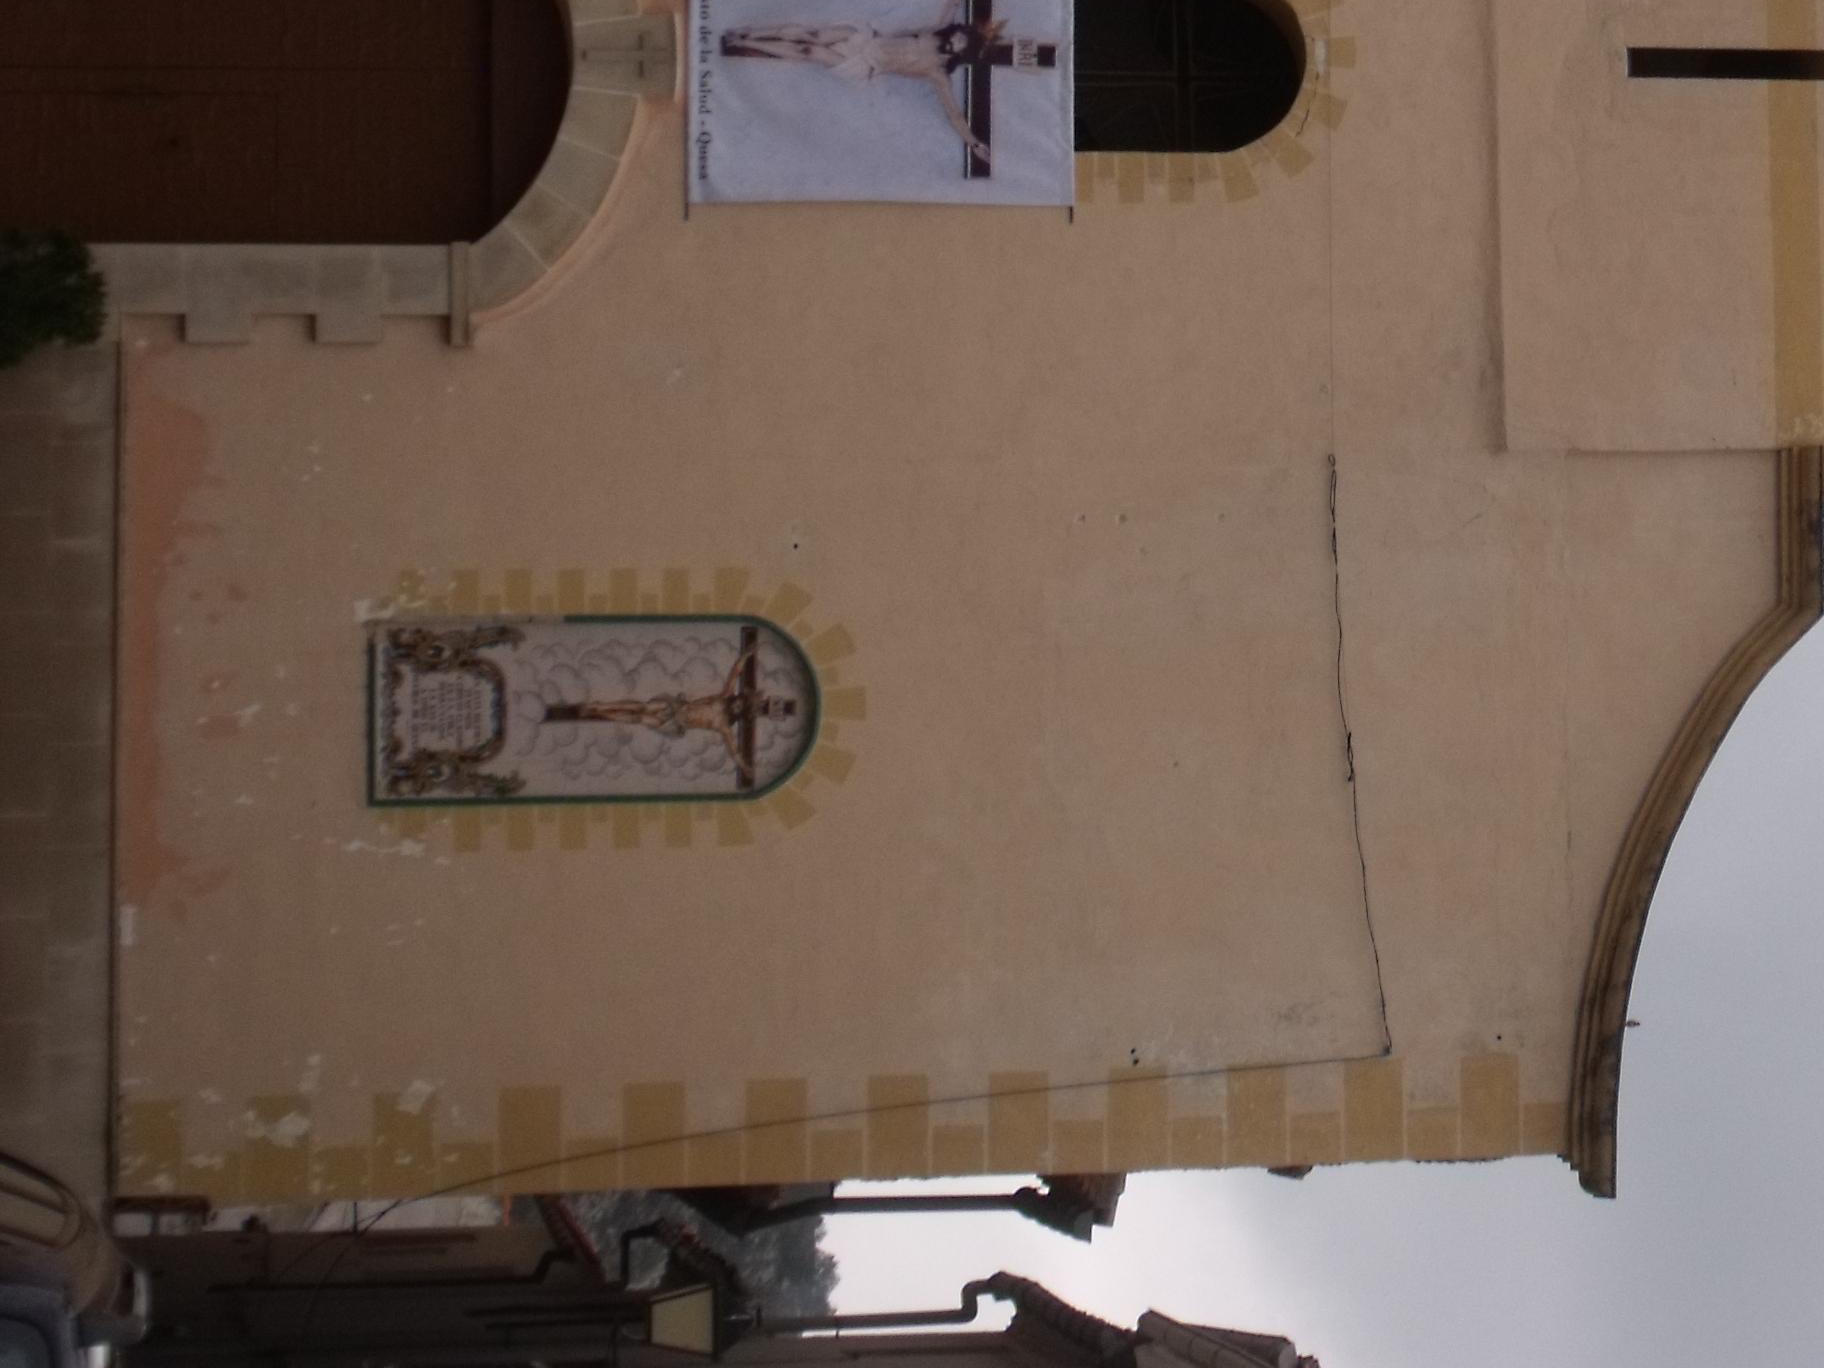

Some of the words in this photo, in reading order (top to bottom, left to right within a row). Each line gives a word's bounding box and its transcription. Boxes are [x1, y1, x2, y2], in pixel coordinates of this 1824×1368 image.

[699, 26, 713, 45] de
[699, 49, 714, 64] la
[698, 69, 714, 115] Salud
[695, 131, 713, 181] Quesa
